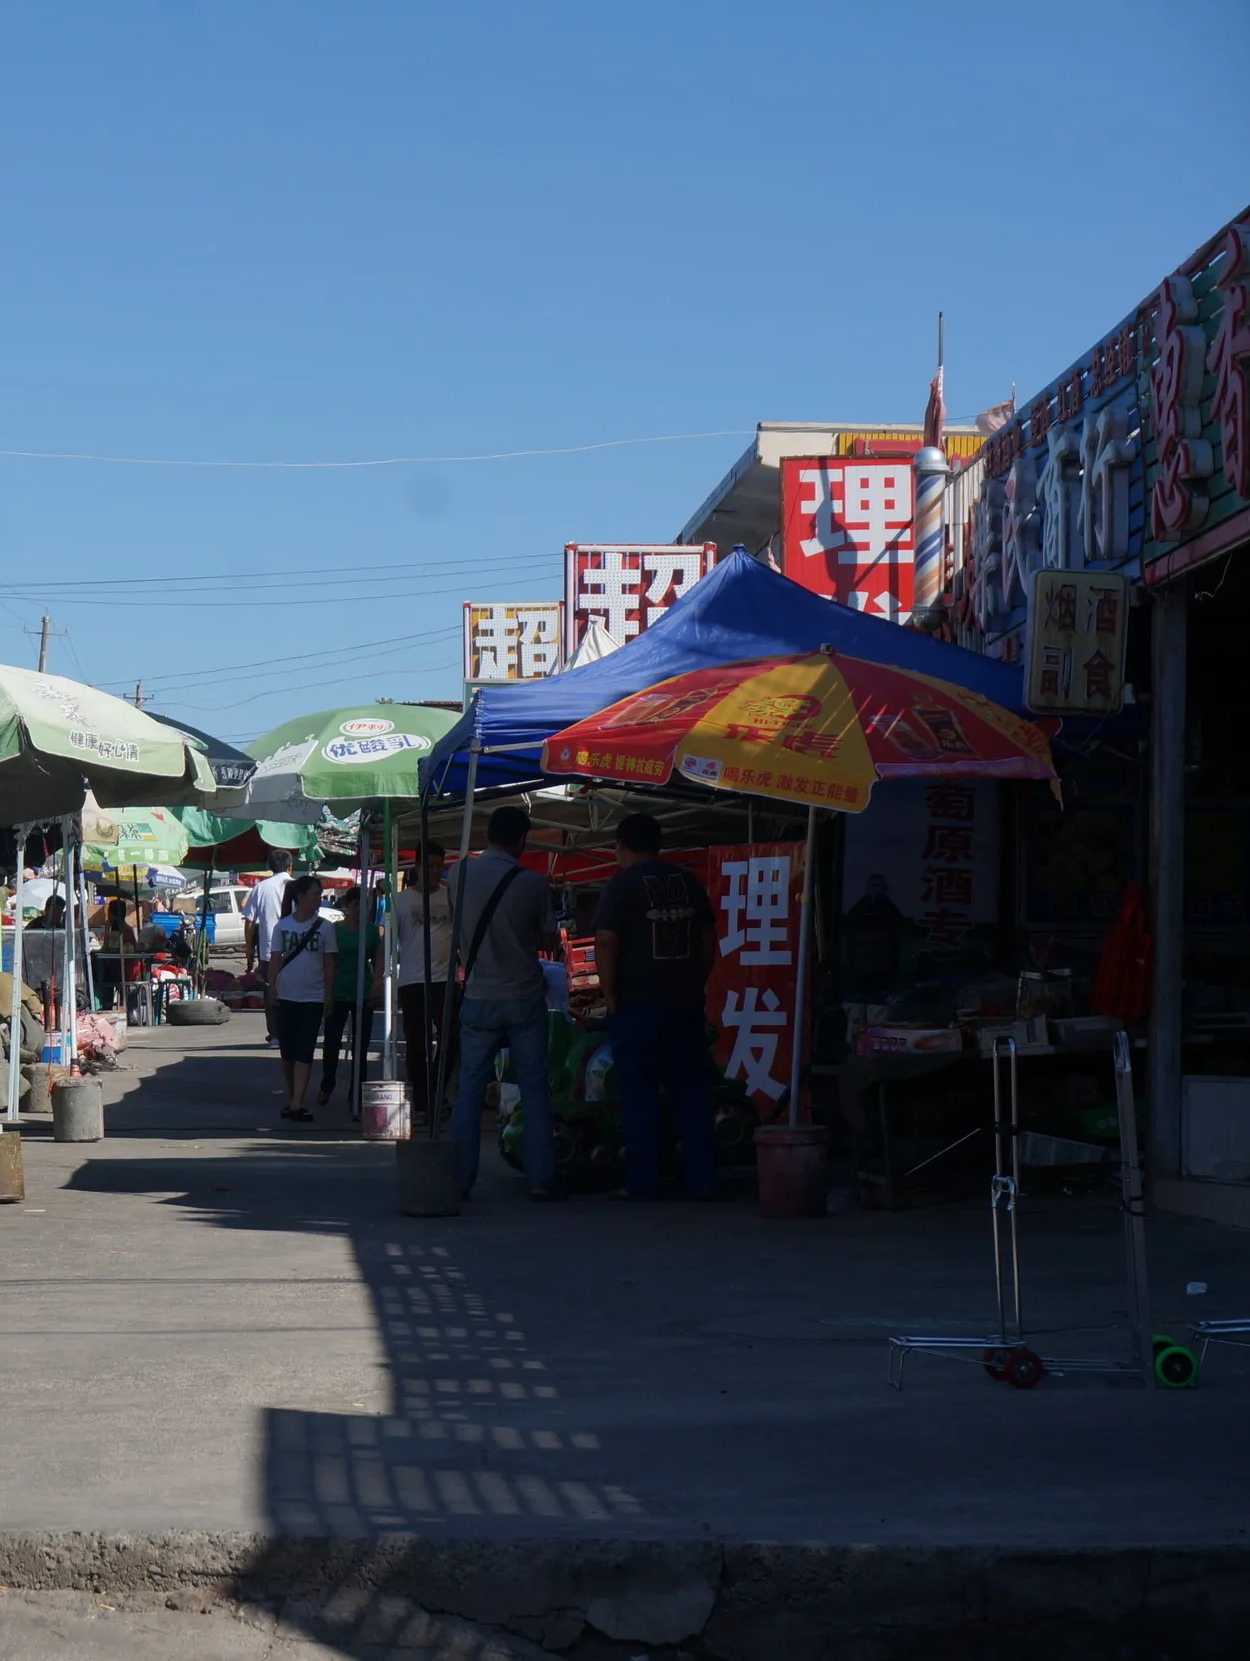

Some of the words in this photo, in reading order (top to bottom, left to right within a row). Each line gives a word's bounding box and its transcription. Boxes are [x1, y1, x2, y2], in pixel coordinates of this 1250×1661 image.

[799, 465, 915, 625] 理
[476, 607, 559, 680] 超
[70, 729, 139, 762] 健康好心情
[348, 722, 386, 732] 伊利
[329, 734, 416, 758] 优酸乳
[723, 766, 773, 787] 喝乐虎
[776, 774, 859, 803] 激发正能量
[719, 856, 793, 1101] 理发
